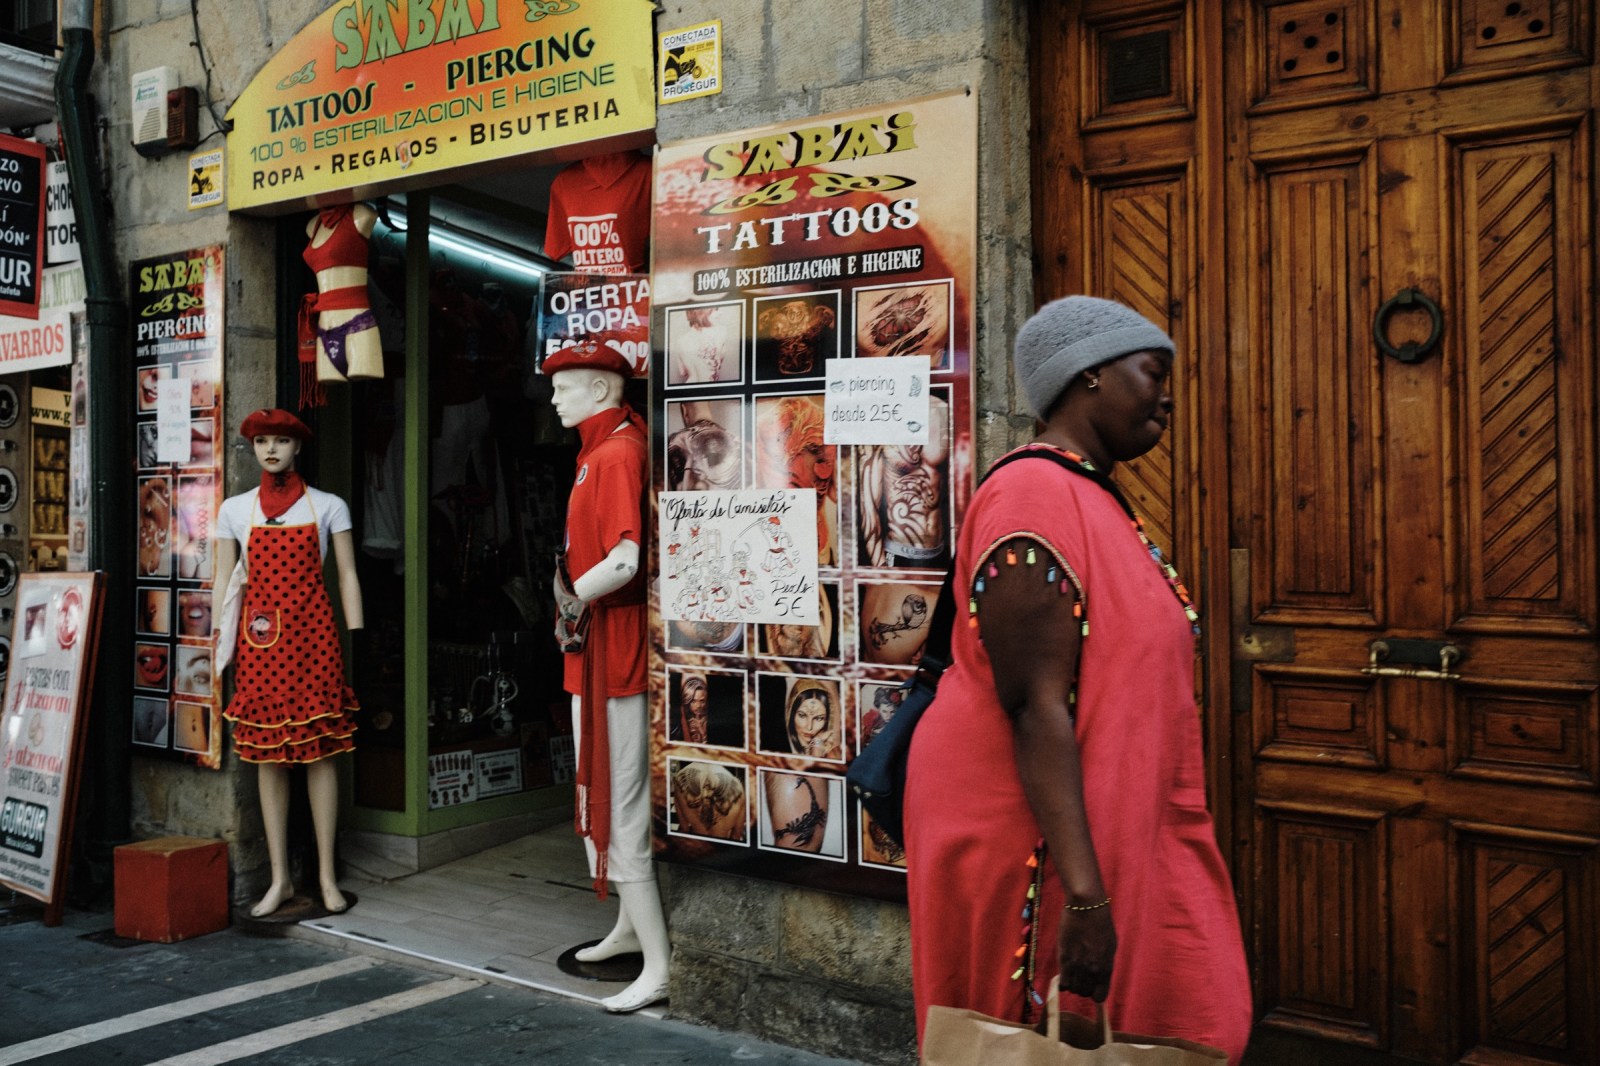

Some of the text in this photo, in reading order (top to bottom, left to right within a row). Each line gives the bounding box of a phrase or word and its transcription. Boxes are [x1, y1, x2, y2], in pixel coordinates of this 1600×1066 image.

[663, 26, 716, 46] CONECTADA
[267, 82, 377, 133] TATTOOS
[446, 26, 596, 91] PIERCING
[250, 140, 284, 163] 100
[313, 93, 484, 150] ESTERILIZACION
[492, 88, 507, 109] E
[515, 63, 616, 104] HIGIENE
[252, 165, 305, 190] ROPA
[470, 98, 620, 146] BISUTERIA
[697, 198, 920, 254] TATTOOS
[697, 247, 922, 291] 100% ESTERILIZACION E HIGIENE
[550, 279, 650, 316] OFERTA
[137, 312, 217, 341] PIERCING
[567, 305, 641, 336] ROPA
[849, 376, 896, 397] piercing
[831, 403, 904, 422] desde 25€
[709, 498, 727, 520] de
[774, 596, 806, 618] 5€
